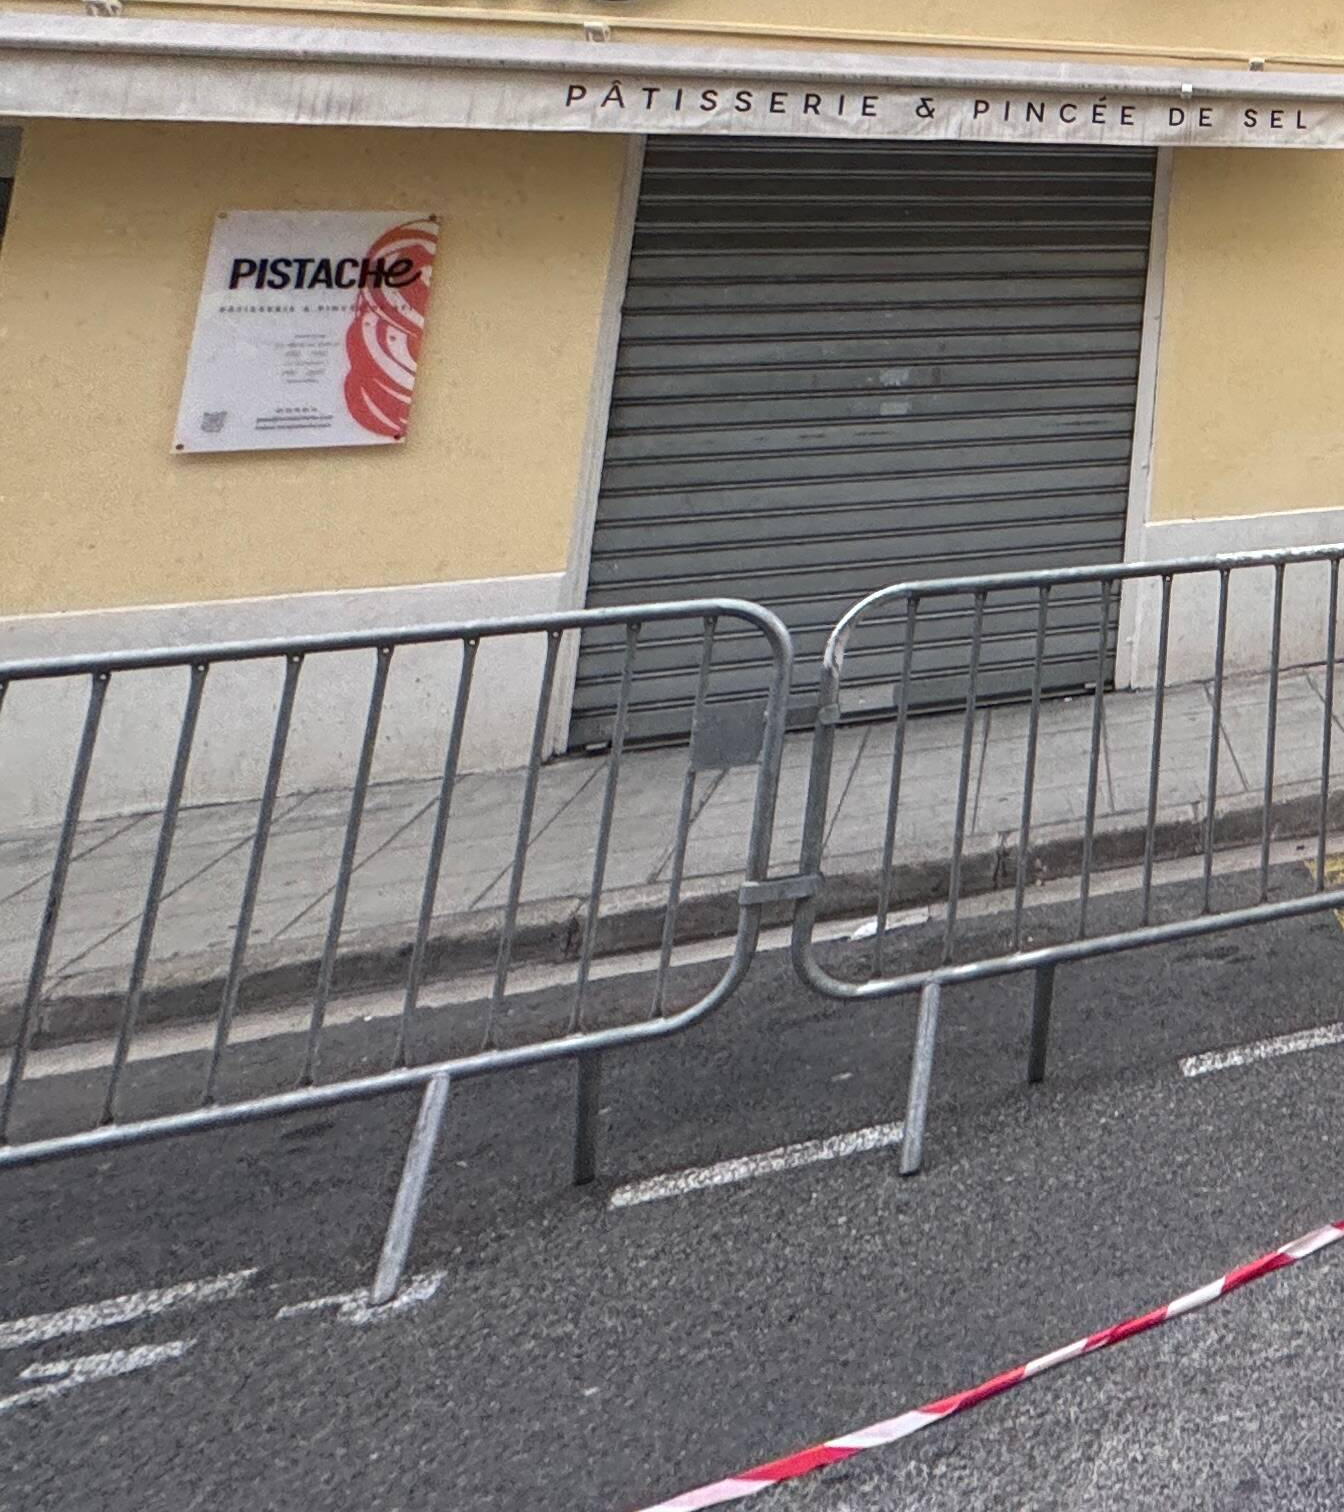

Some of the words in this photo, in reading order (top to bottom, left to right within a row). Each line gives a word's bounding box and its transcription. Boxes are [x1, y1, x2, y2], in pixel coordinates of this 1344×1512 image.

[565, 80, 879, 118] PÂTISSERIE
[915, 97, 936, 119] &
[973, 96, 1136, 126] PINCÉE
[1168, 106, 1213, 128] DE
[1243, 108, 1307, 129] SEL
[229, 258, 422, 290] PISTACHe
